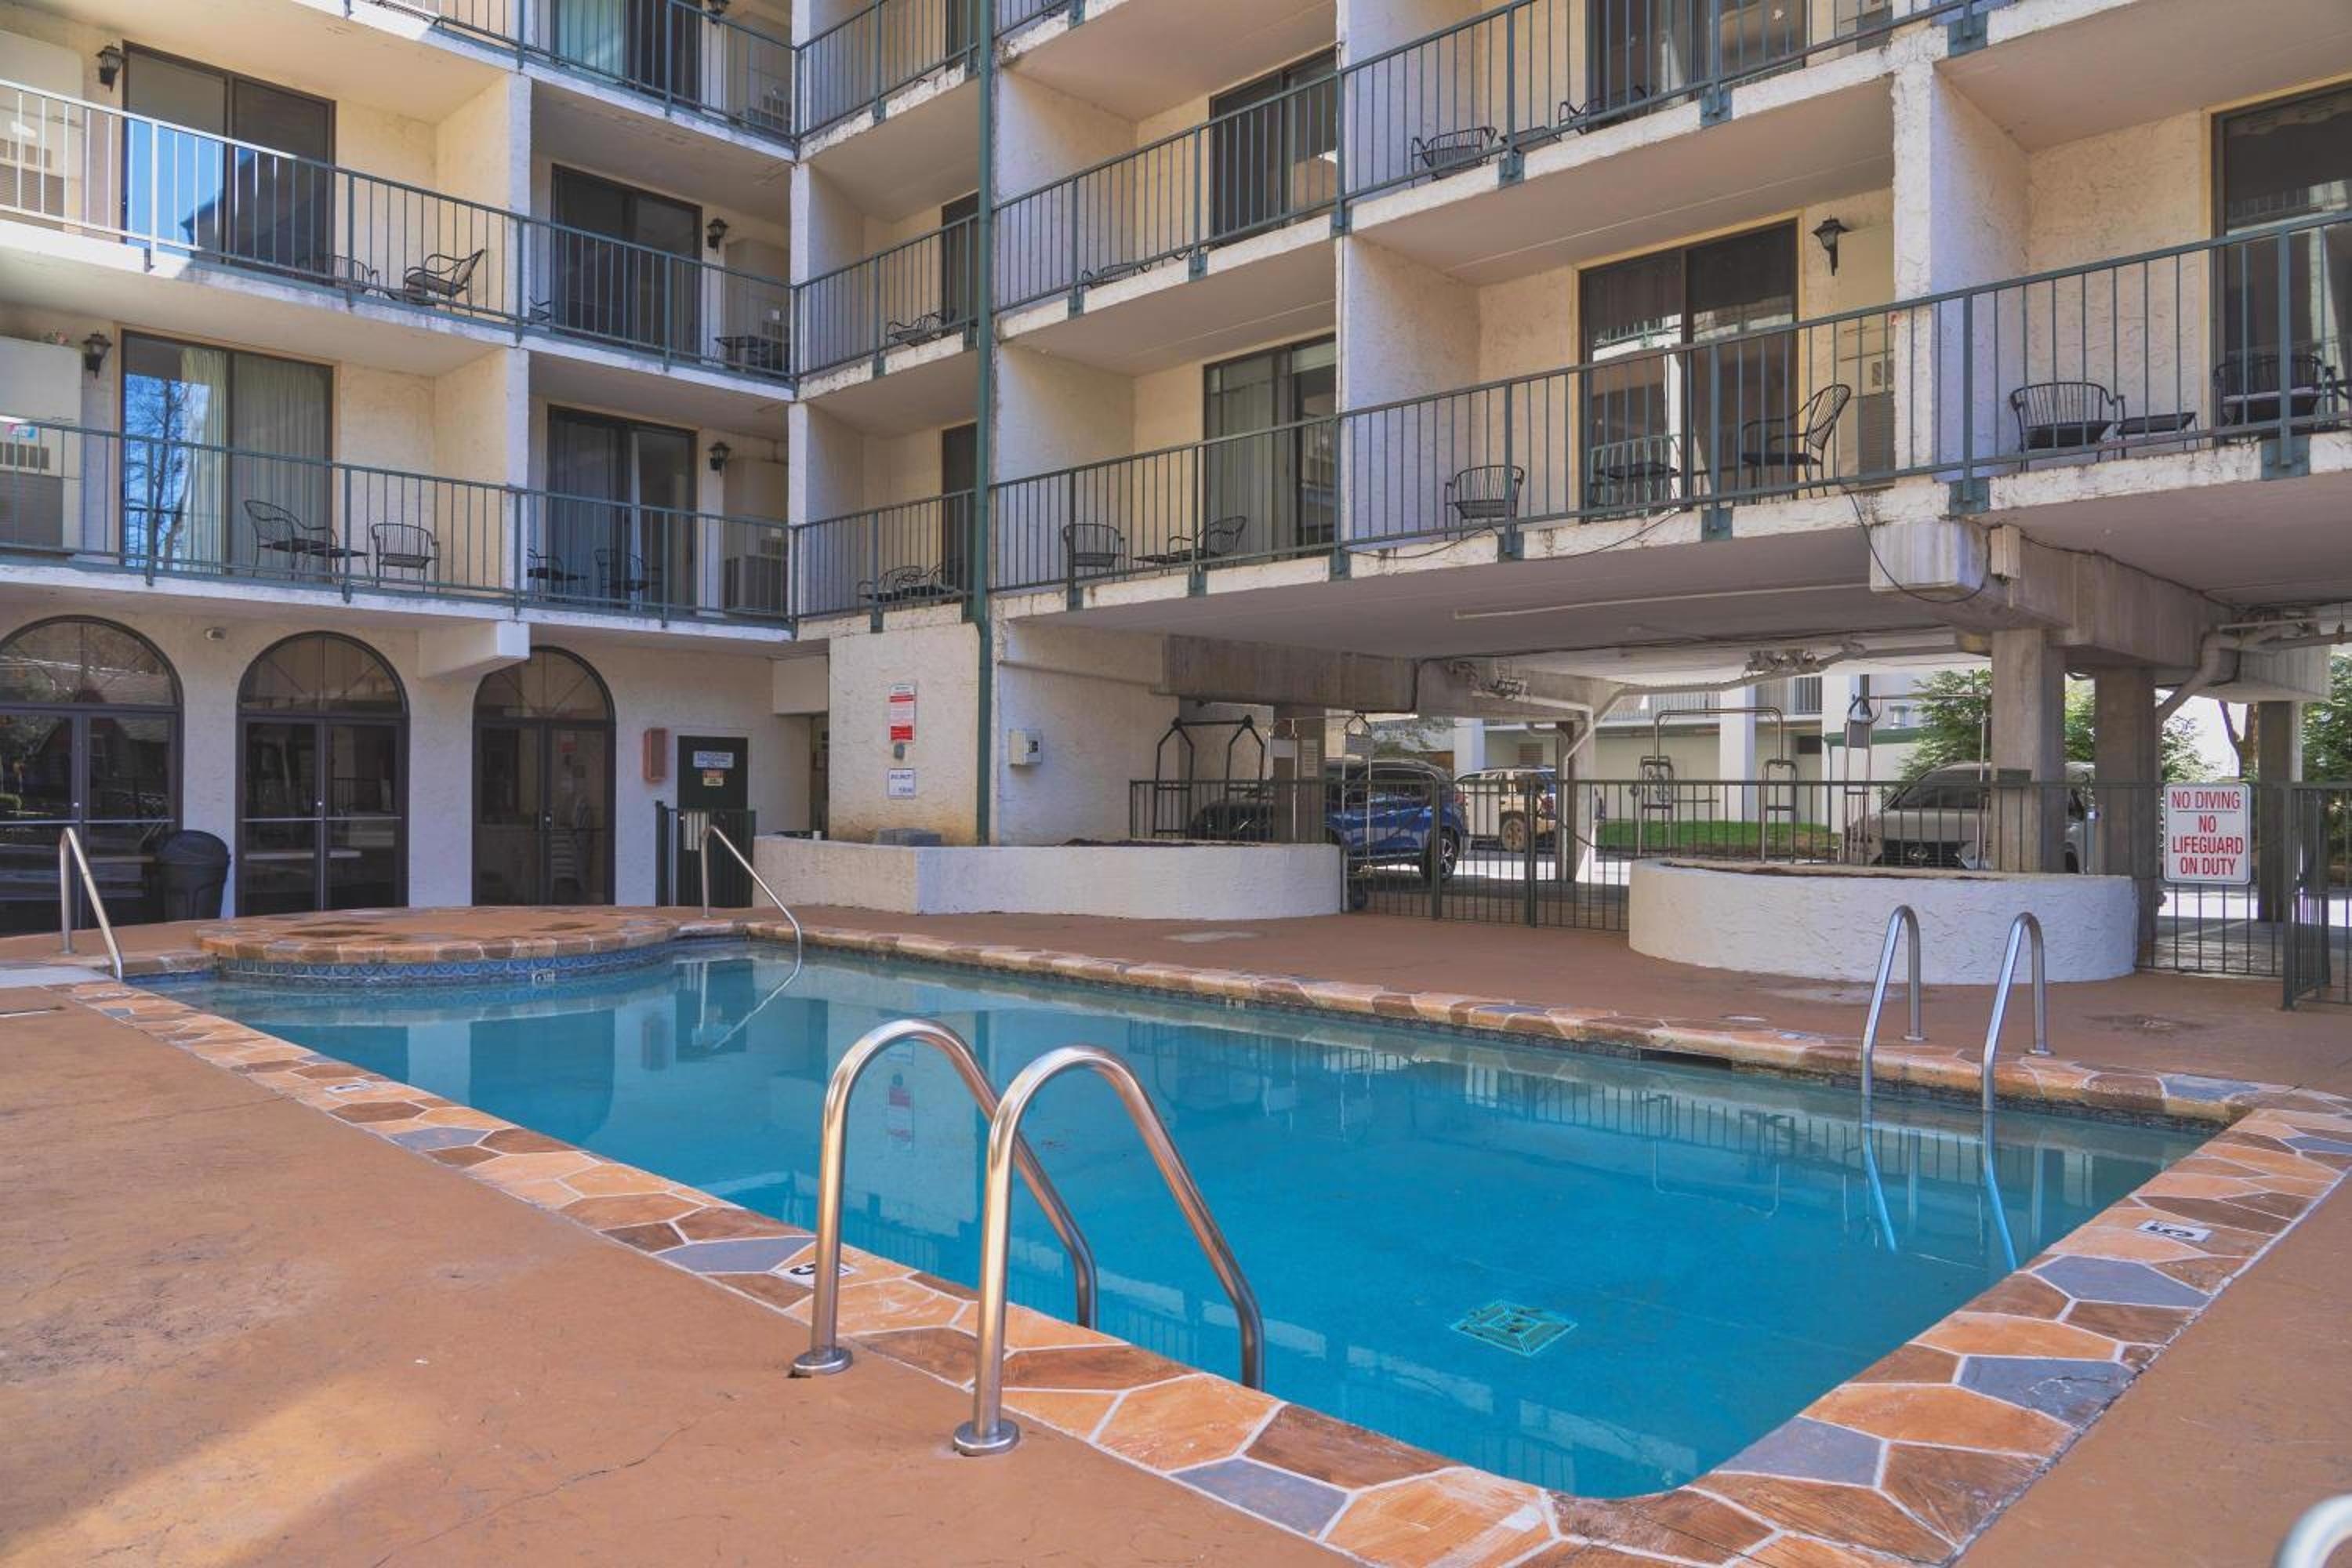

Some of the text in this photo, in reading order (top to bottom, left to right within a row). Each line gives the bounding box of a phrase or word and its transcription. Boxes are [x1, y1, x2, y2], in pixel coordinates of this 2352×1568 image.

[2171, 791, 2240, 809] NO DIVING
[2198, 815, 2216, 833] NO
[2172, 836, 2244, 855] LIFEGUARD
[2180, 857, 2236, 876] ON DUTY
